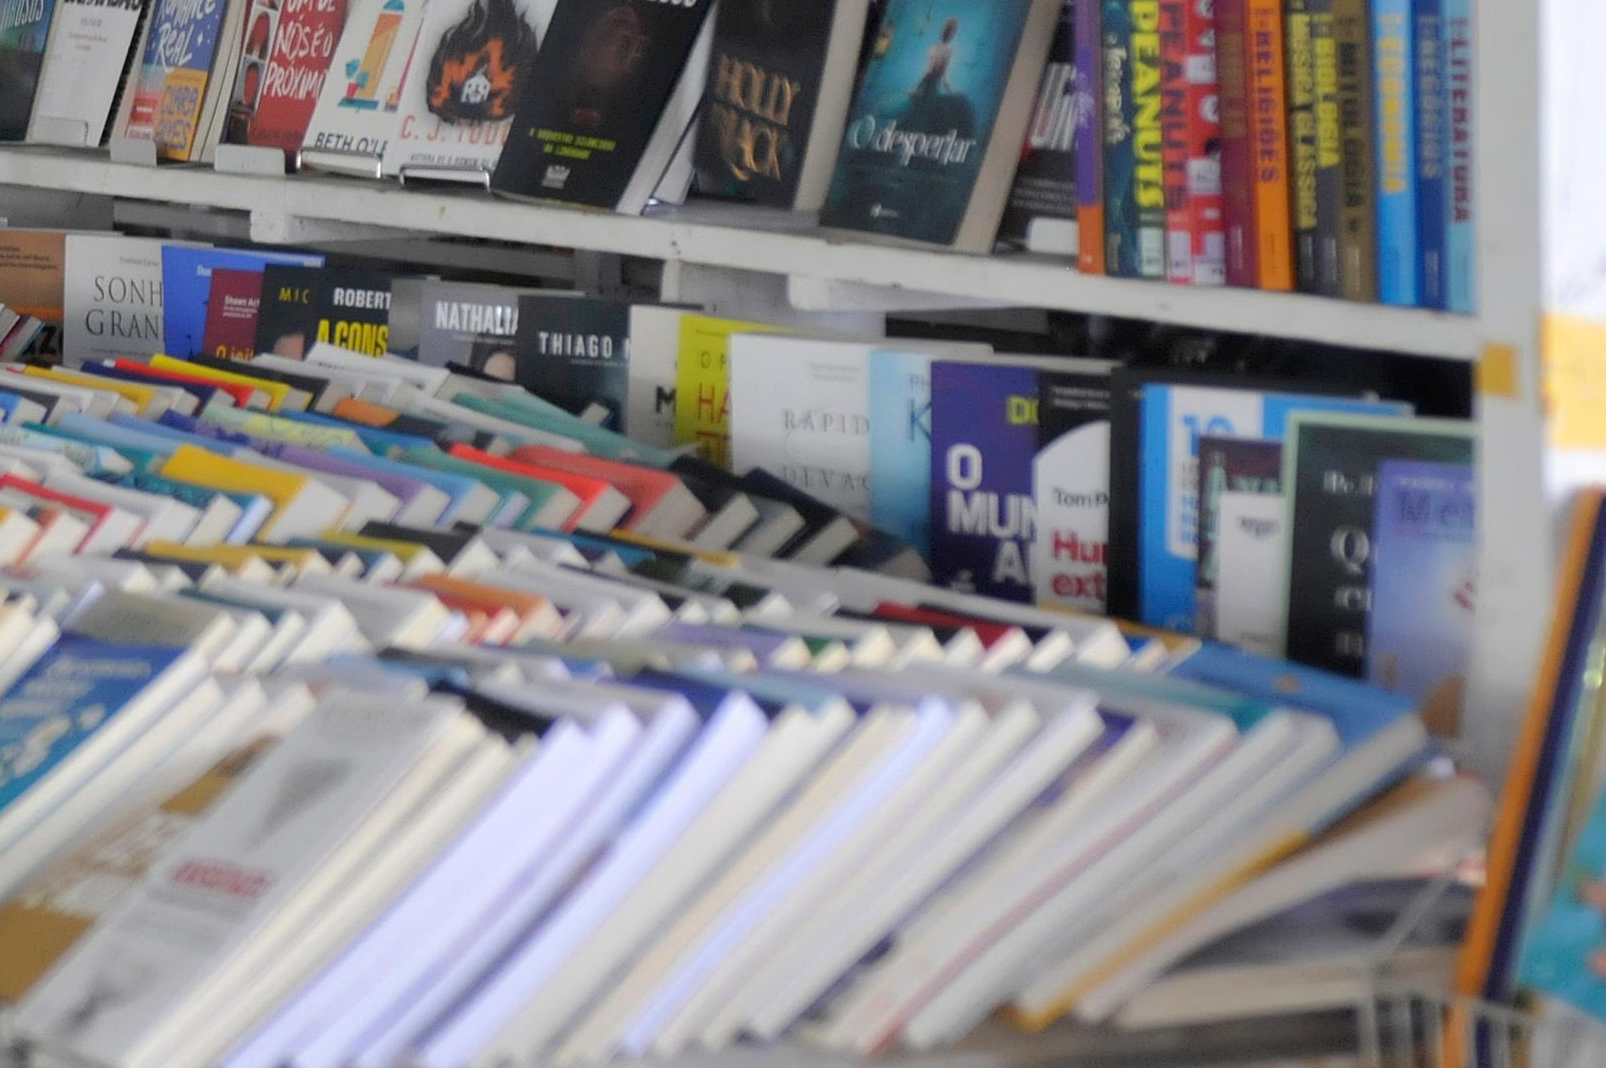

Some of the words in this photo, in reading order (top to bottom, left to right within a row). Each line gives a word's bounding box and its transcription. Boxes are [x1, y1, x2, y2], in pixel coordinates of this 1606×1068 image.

[263, 58, 328, 101] PRÓXIM
[457, 119, 508, 147] TUDO
[94, 276, 162, 306] SONH
[85, 308, 160, 340] GRAN
[539, 331, 614, 359] THIAGO
[946, 443, 983, 491] O
